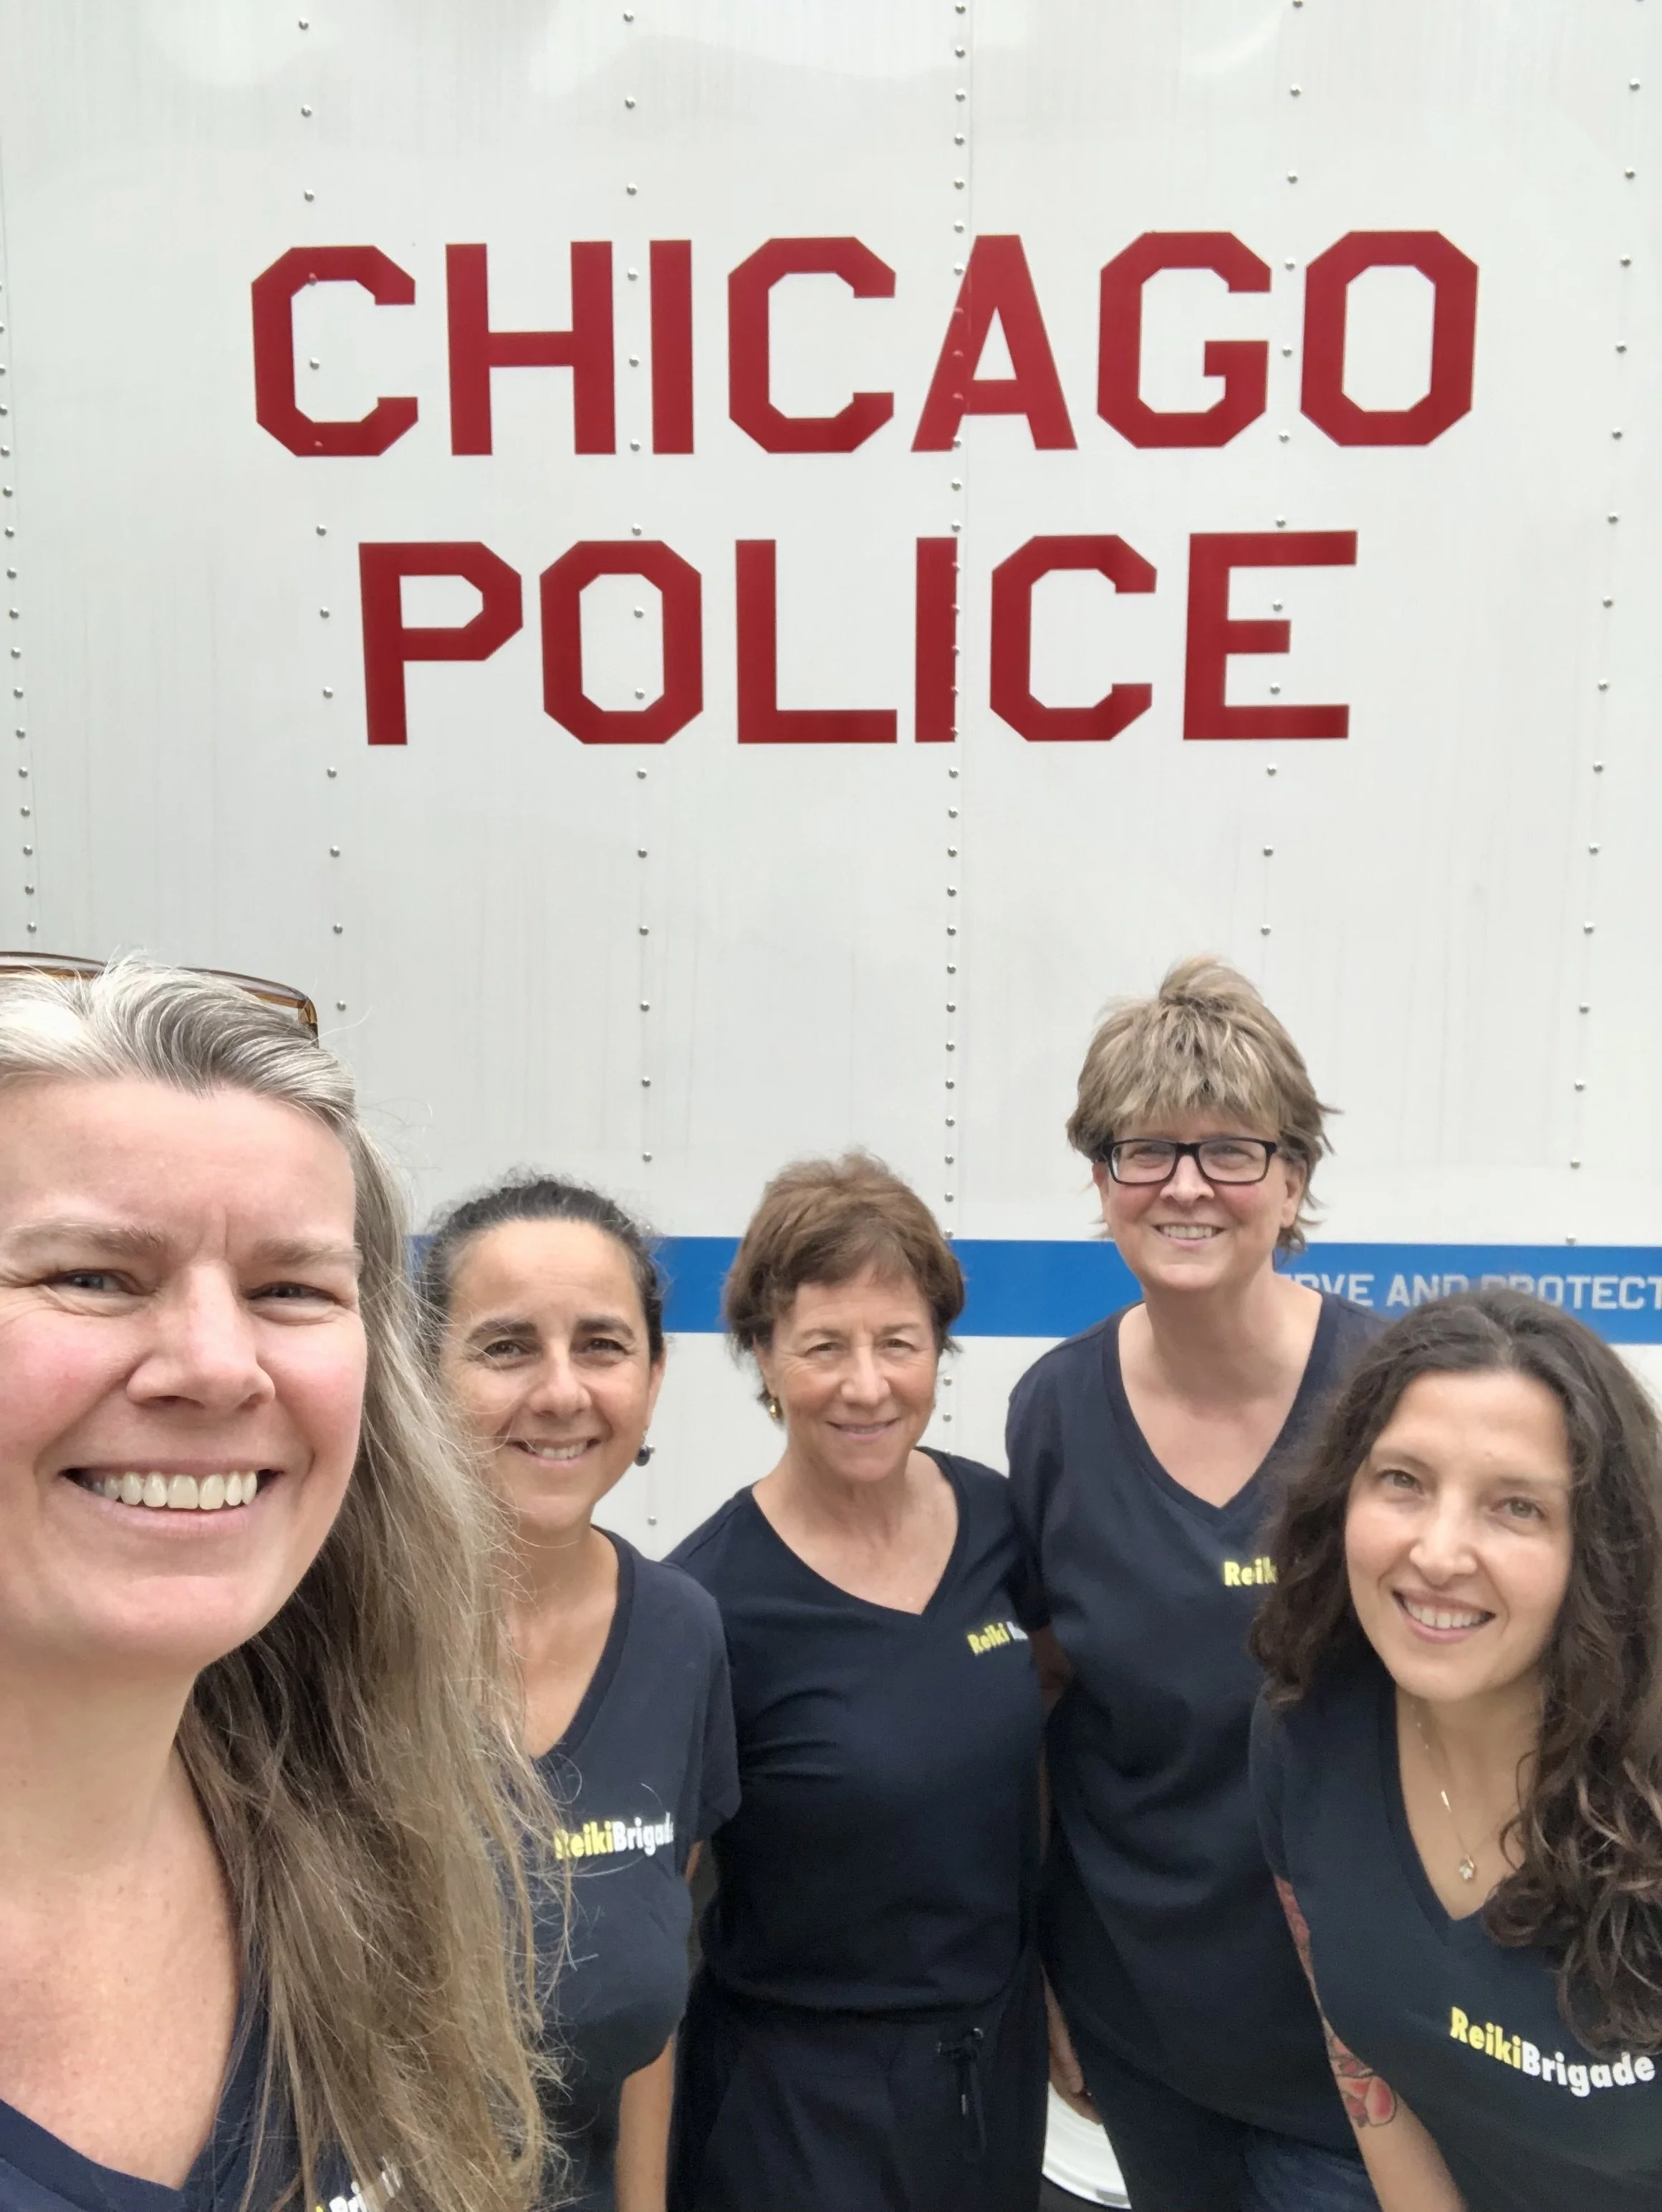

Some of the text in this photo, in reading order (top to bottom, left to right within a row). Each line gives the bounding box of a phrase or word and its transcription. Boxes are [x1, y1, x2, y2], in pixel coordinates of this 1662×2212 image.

[251, 231, 1479, 456] CHICAGO
[359, 531, 1358, 745] POLICE
[1449, 2006, 1656, 2097] ReikiBrigade
